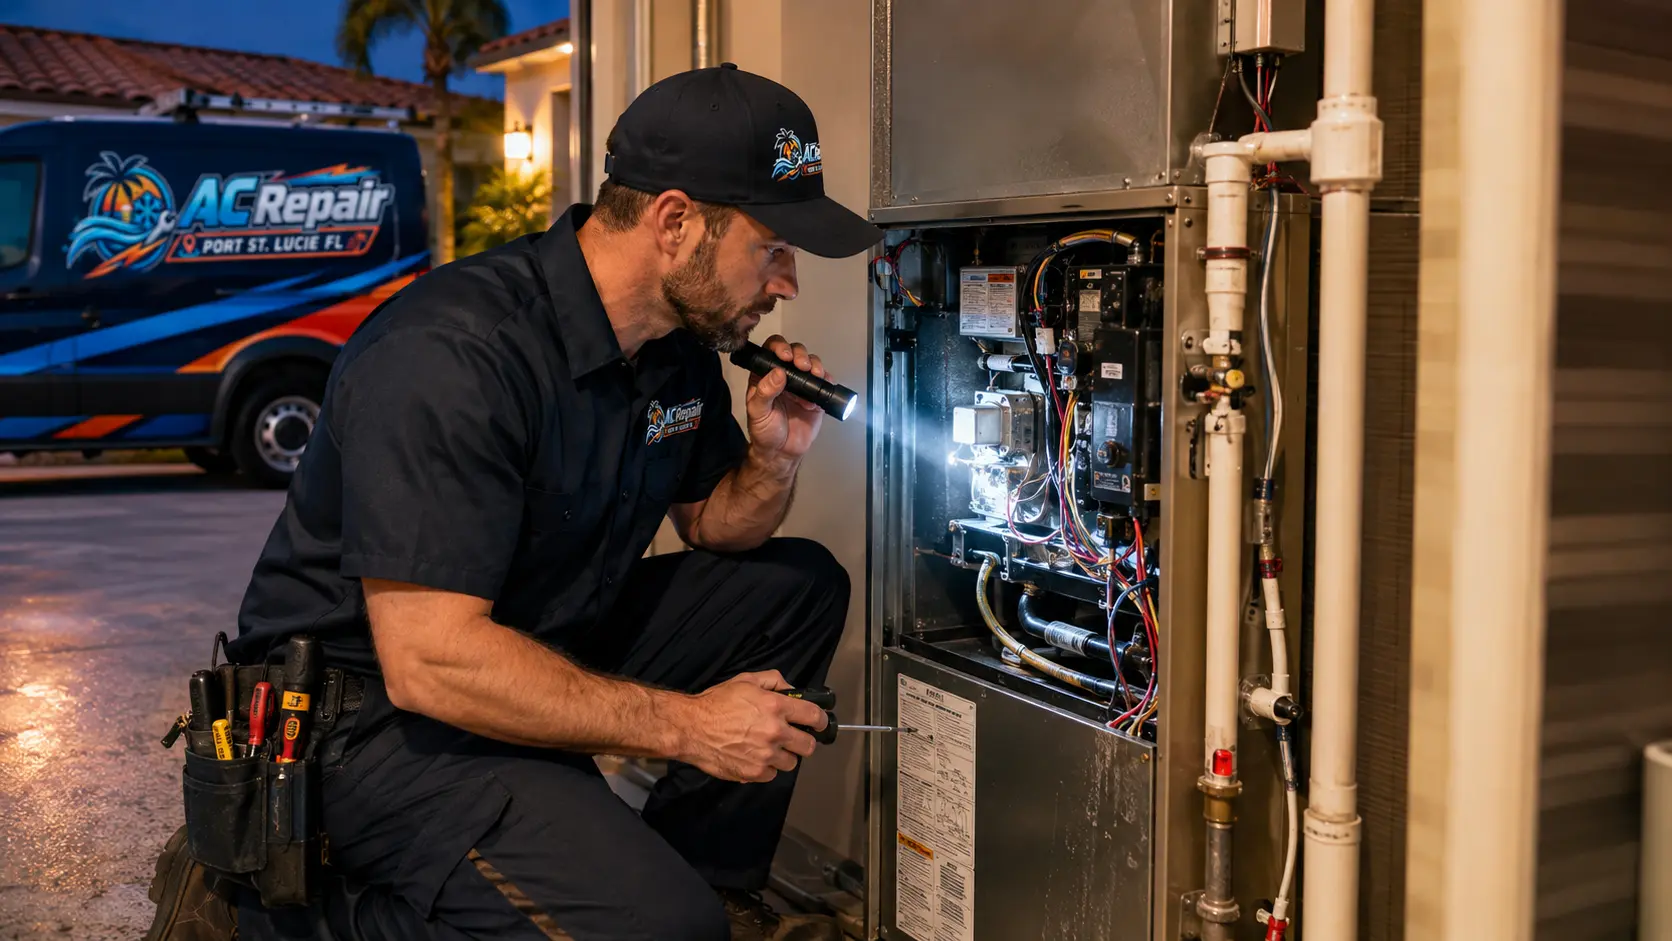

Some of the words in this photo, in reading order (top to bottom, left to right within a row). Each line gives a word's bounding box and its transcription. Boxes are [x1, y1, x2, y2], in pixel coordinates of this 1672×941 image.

[179, 177, 258, 227] AC
[254, 181, 389, 229] Repair
[202, 237, 243, 254] PORT
[247, 237, 269, 253] ST.
[273, 236, 319, 252] LUCIE
[324, 235, 343, 251] FL
